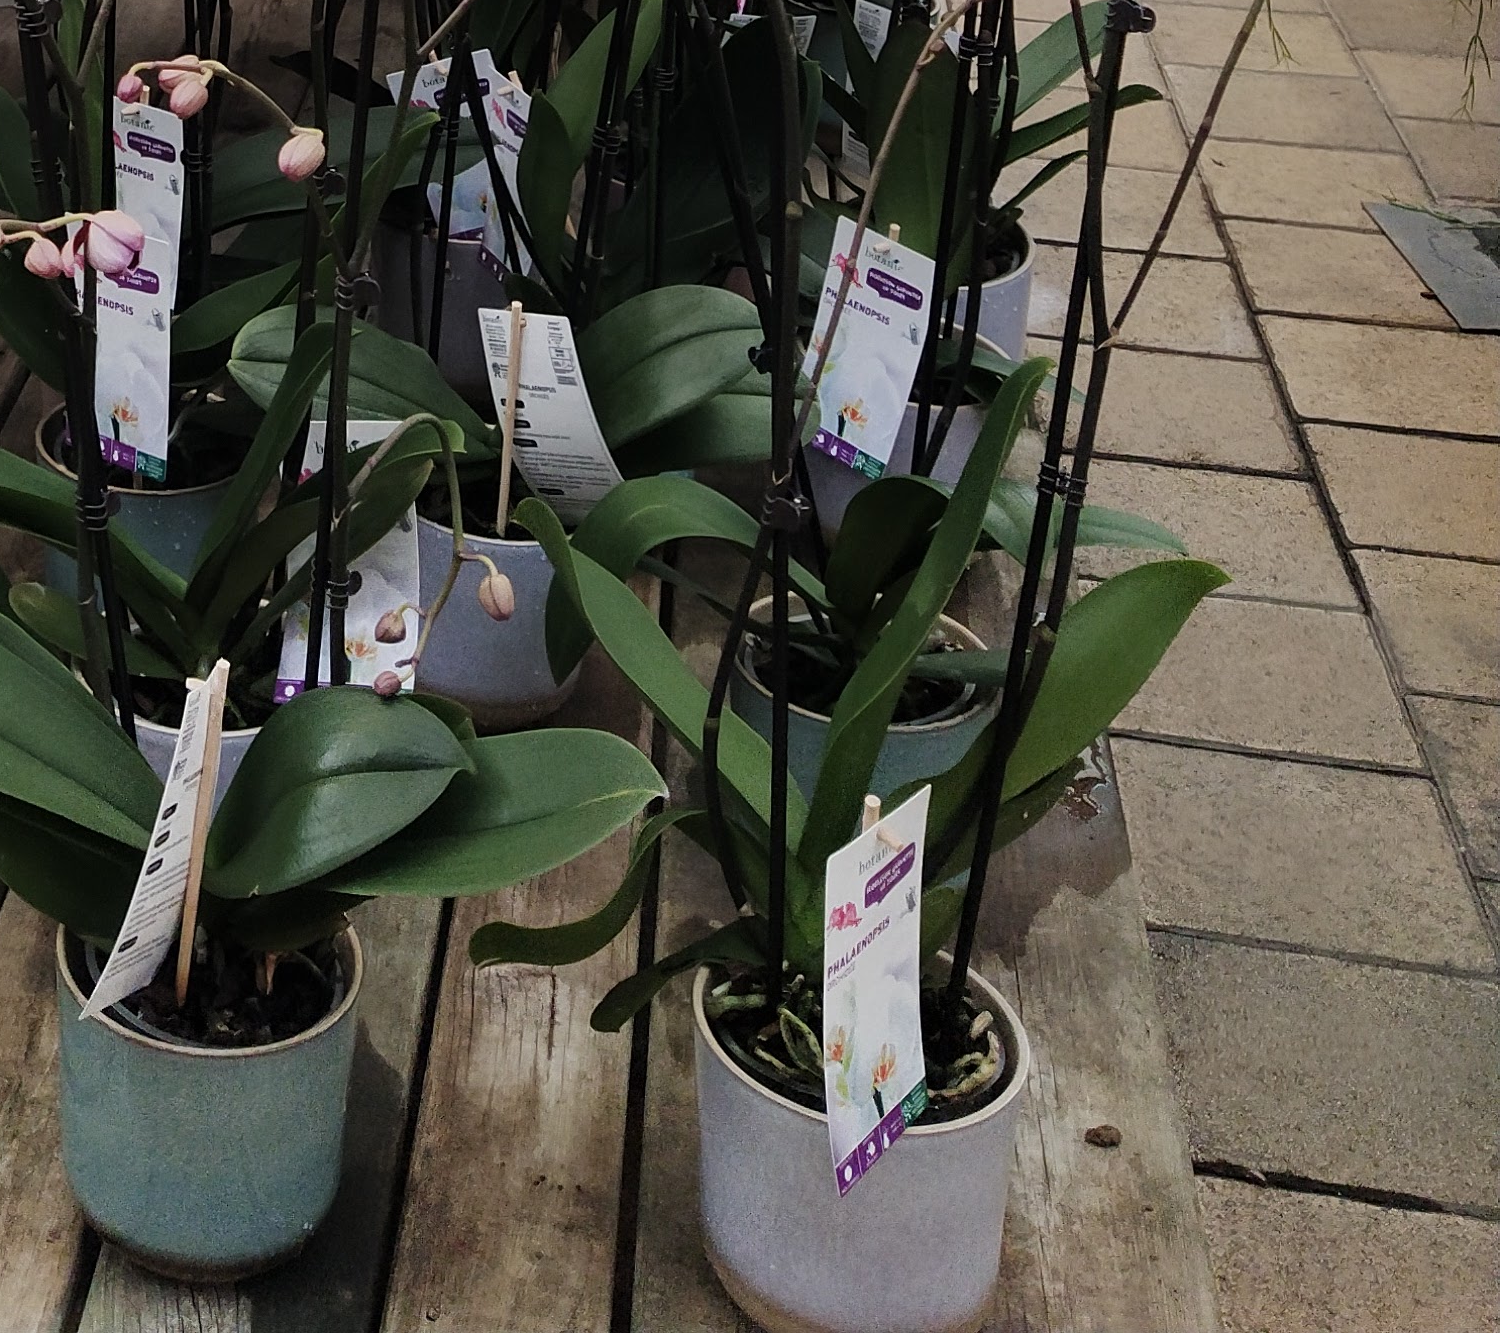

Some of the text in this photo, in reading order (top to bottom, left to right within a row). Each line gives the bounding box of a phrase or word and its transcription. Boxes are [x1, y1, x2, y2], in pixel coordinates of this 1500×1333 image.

[422, 77, 446, 88] bota
[825, 286, 890, 326] PHAENOPSIS
[859, 843, 893, 876] botan
[827, 915, 891, 980] PHALAENOPSIS
